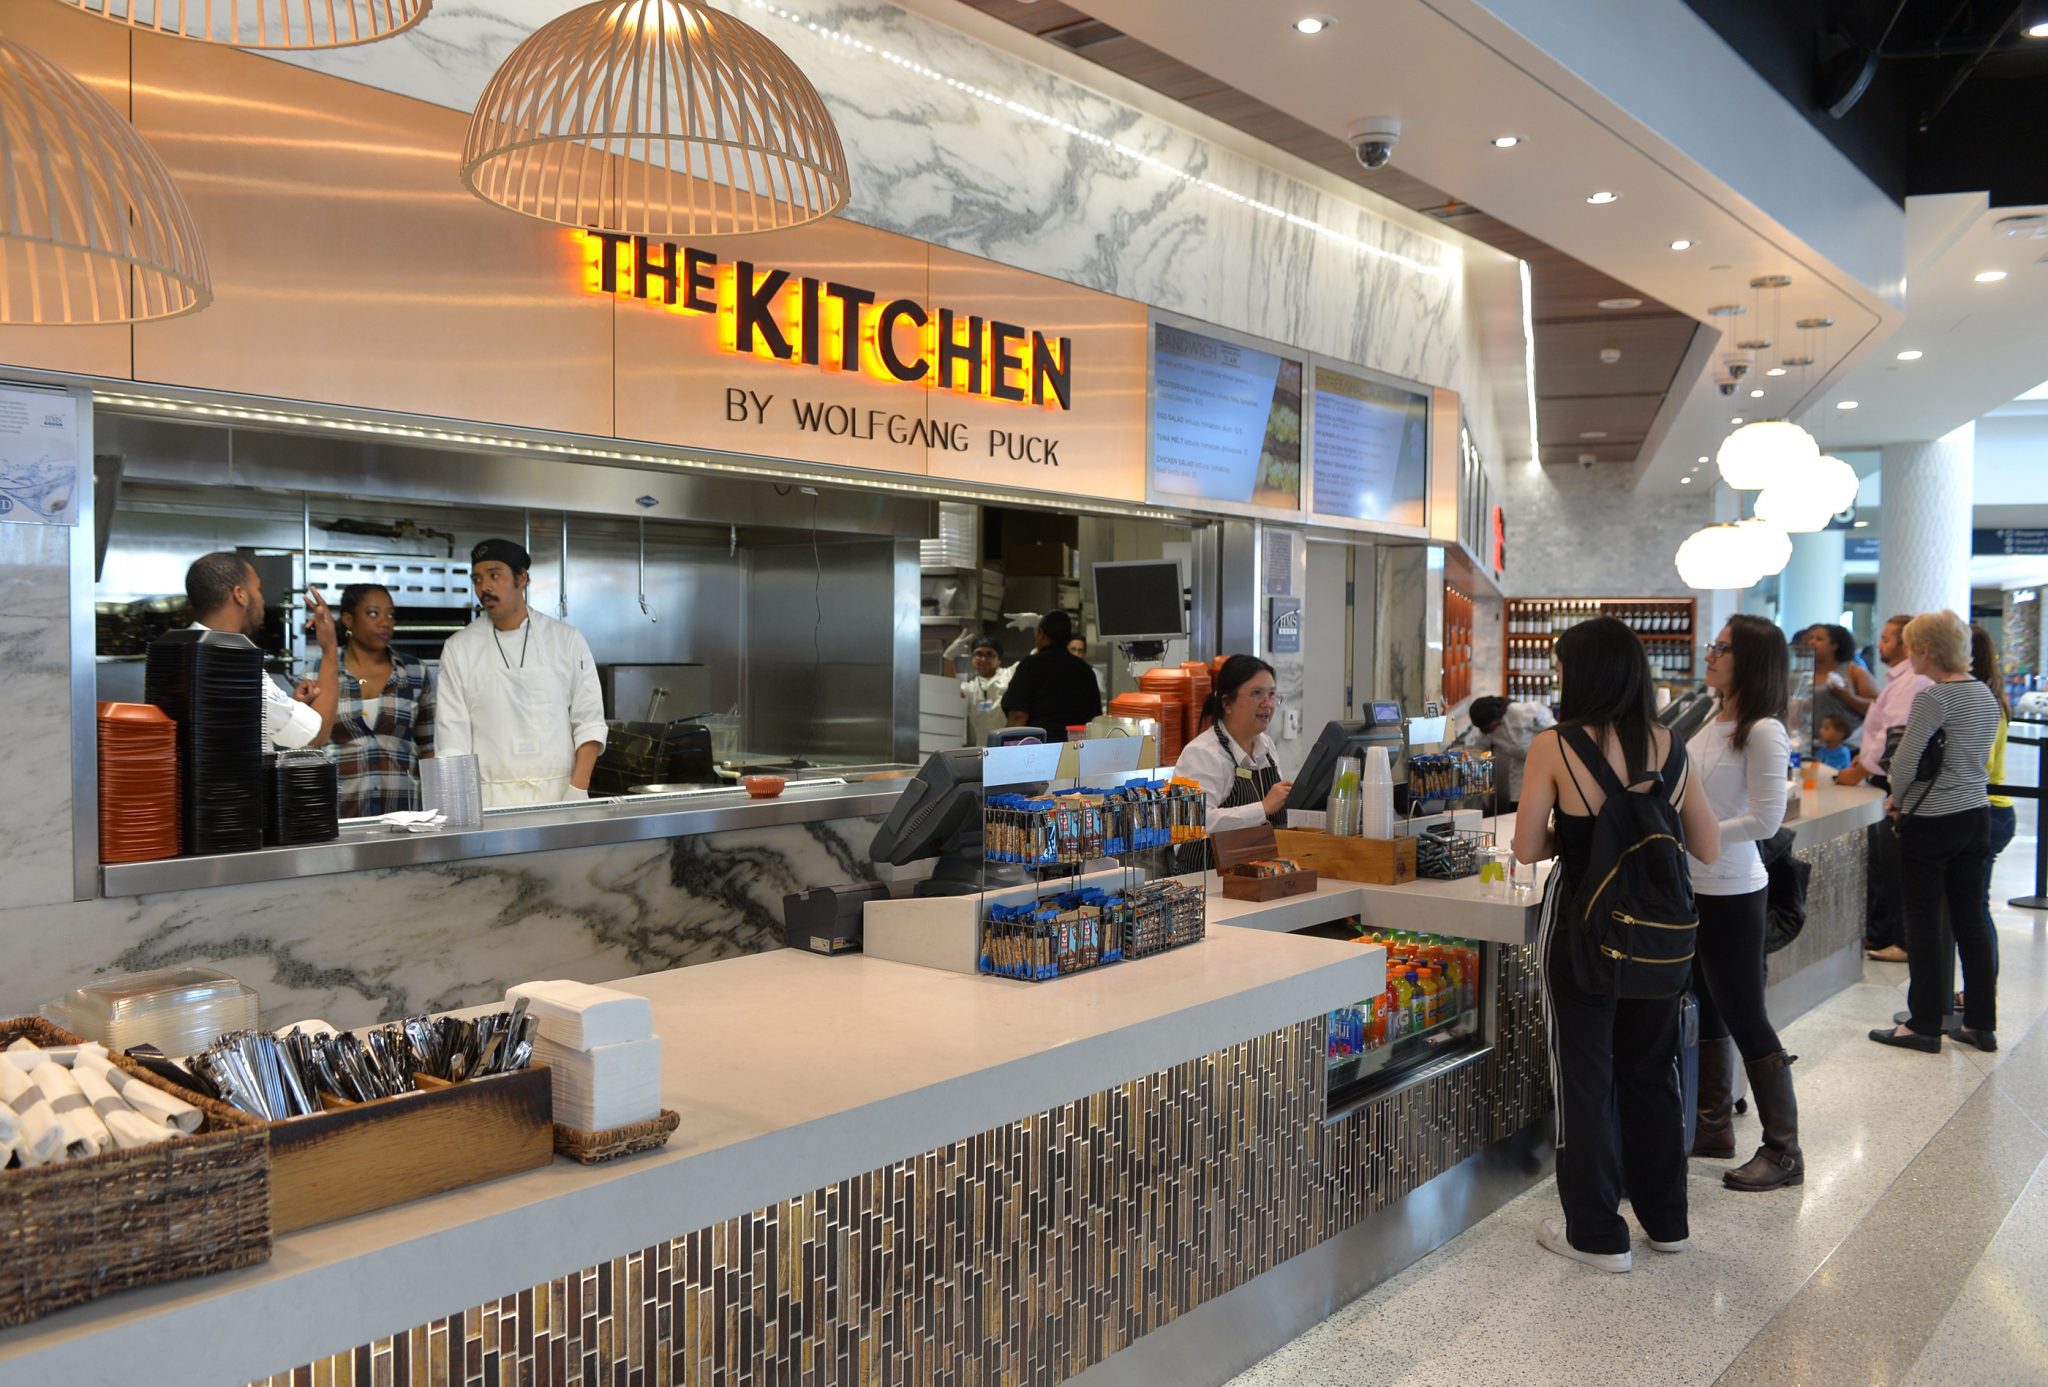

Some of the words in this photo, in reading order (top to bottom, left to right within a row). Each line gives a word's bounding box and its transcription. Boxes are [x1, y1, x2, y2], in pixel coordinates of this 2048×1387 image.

[588, 227, 717, 314] THE
[735, 261, 1071, 410] KITCHEN
[1157, 331, 1217, 360] SANDWICH
[726, 387, 774, 424] BY
[793, 398, 970, 452] WOLFGANG
[990, 430, 1059, 466] PUCK
[1156, 433, 1171, 443] TUNA
[1171, 435, 1184, 445] MELT
[1156, 455, 1178, 466] CHICKEN
[1280, 615, 1297, 628] HMS
